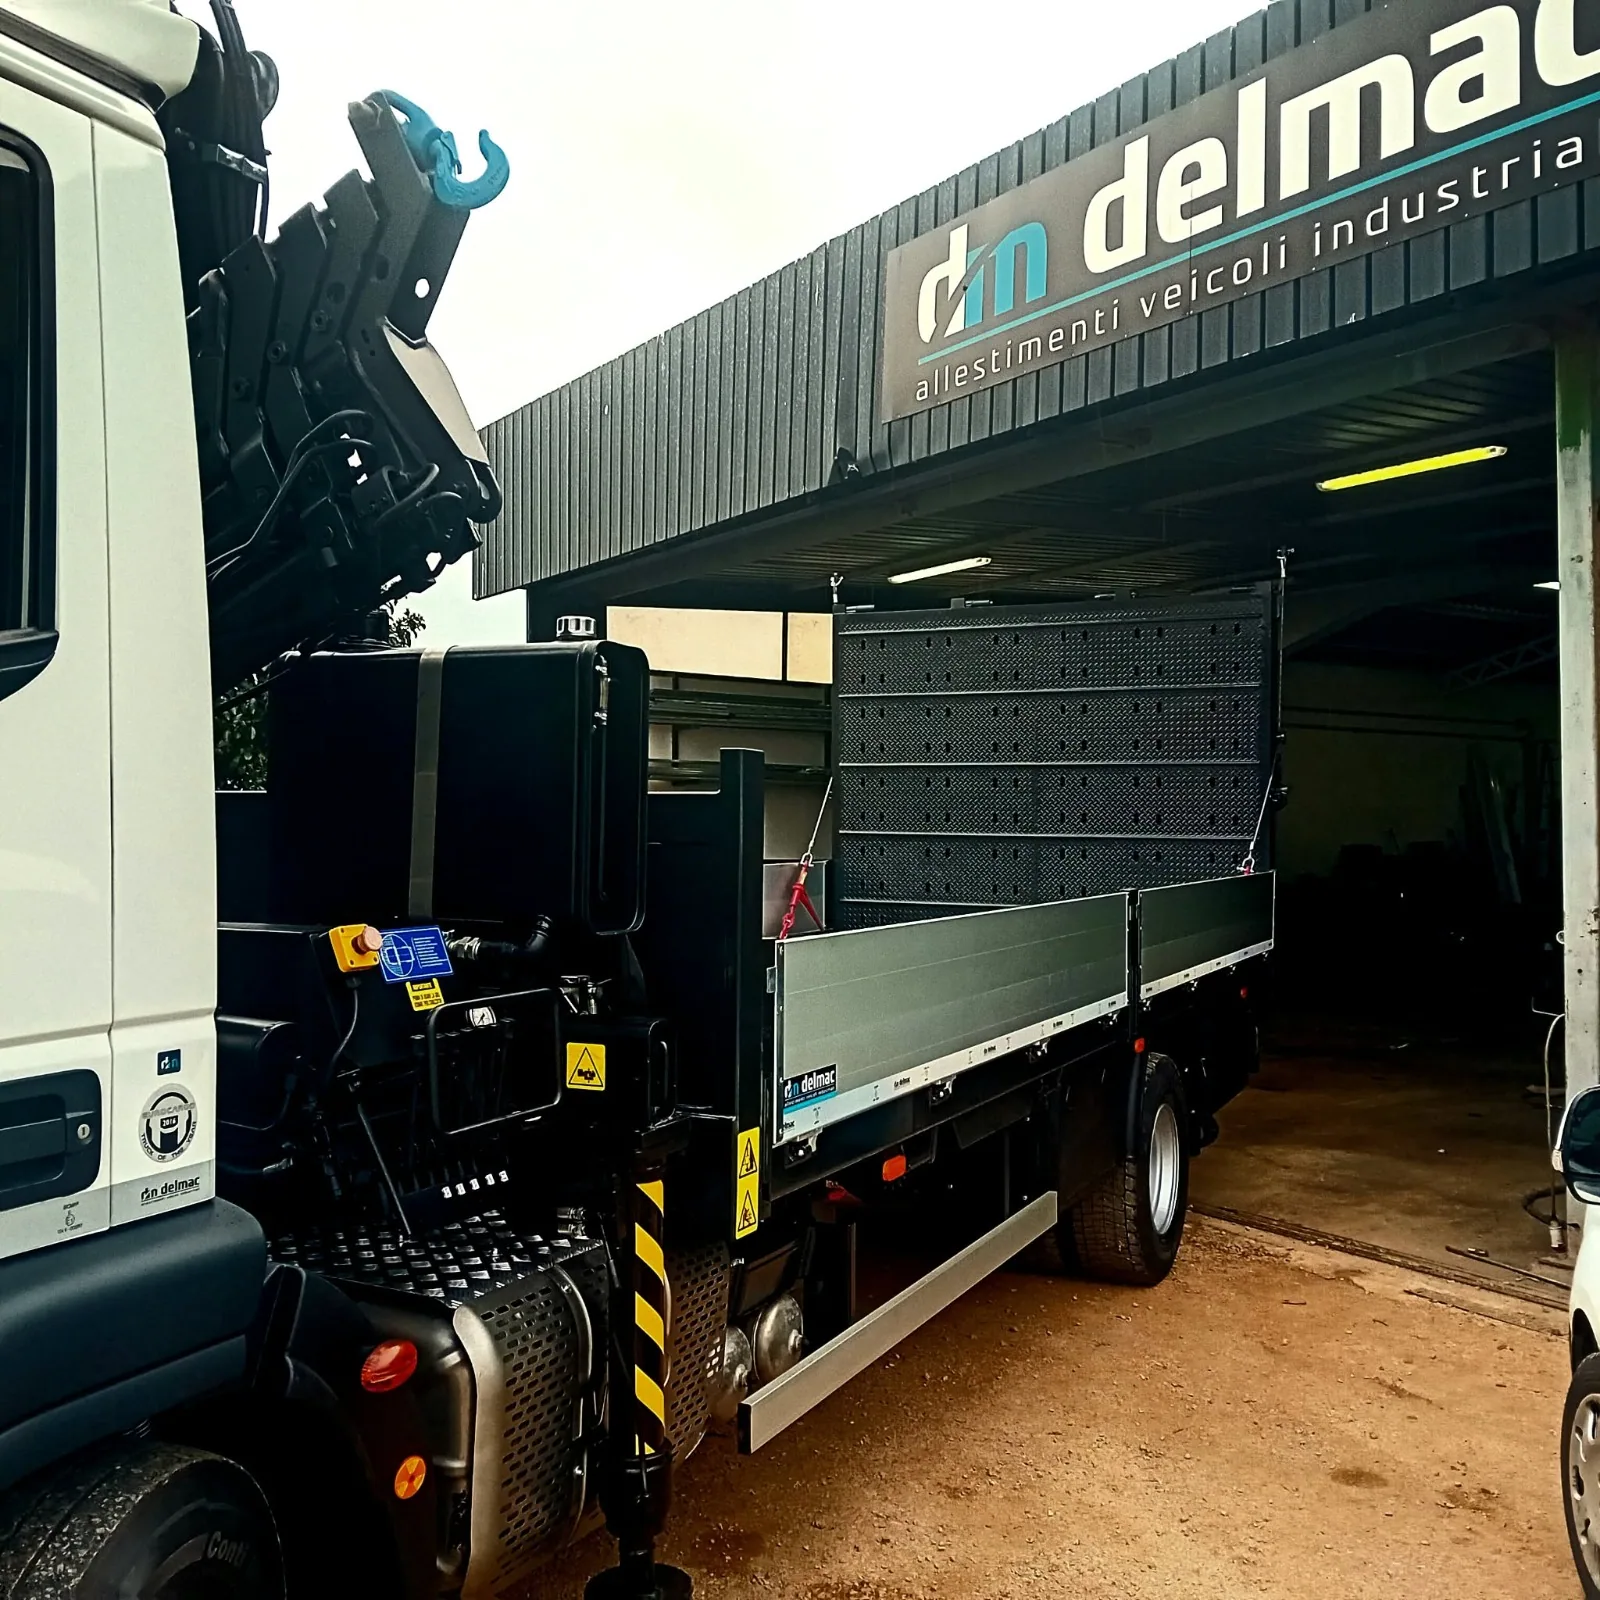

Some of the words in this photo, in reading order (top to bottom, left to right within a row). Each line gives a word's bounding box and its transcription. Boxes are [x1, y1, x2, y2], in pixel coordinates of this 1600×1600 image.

[915, 299, 1120, 401] allestimenti
[1140, 235, 1288, 319] veicoli
[1314, 117, 1600, 258] industria
[801, 1070, 835, 1092] delmac
[160, 1176, 200, 1195] delmac
